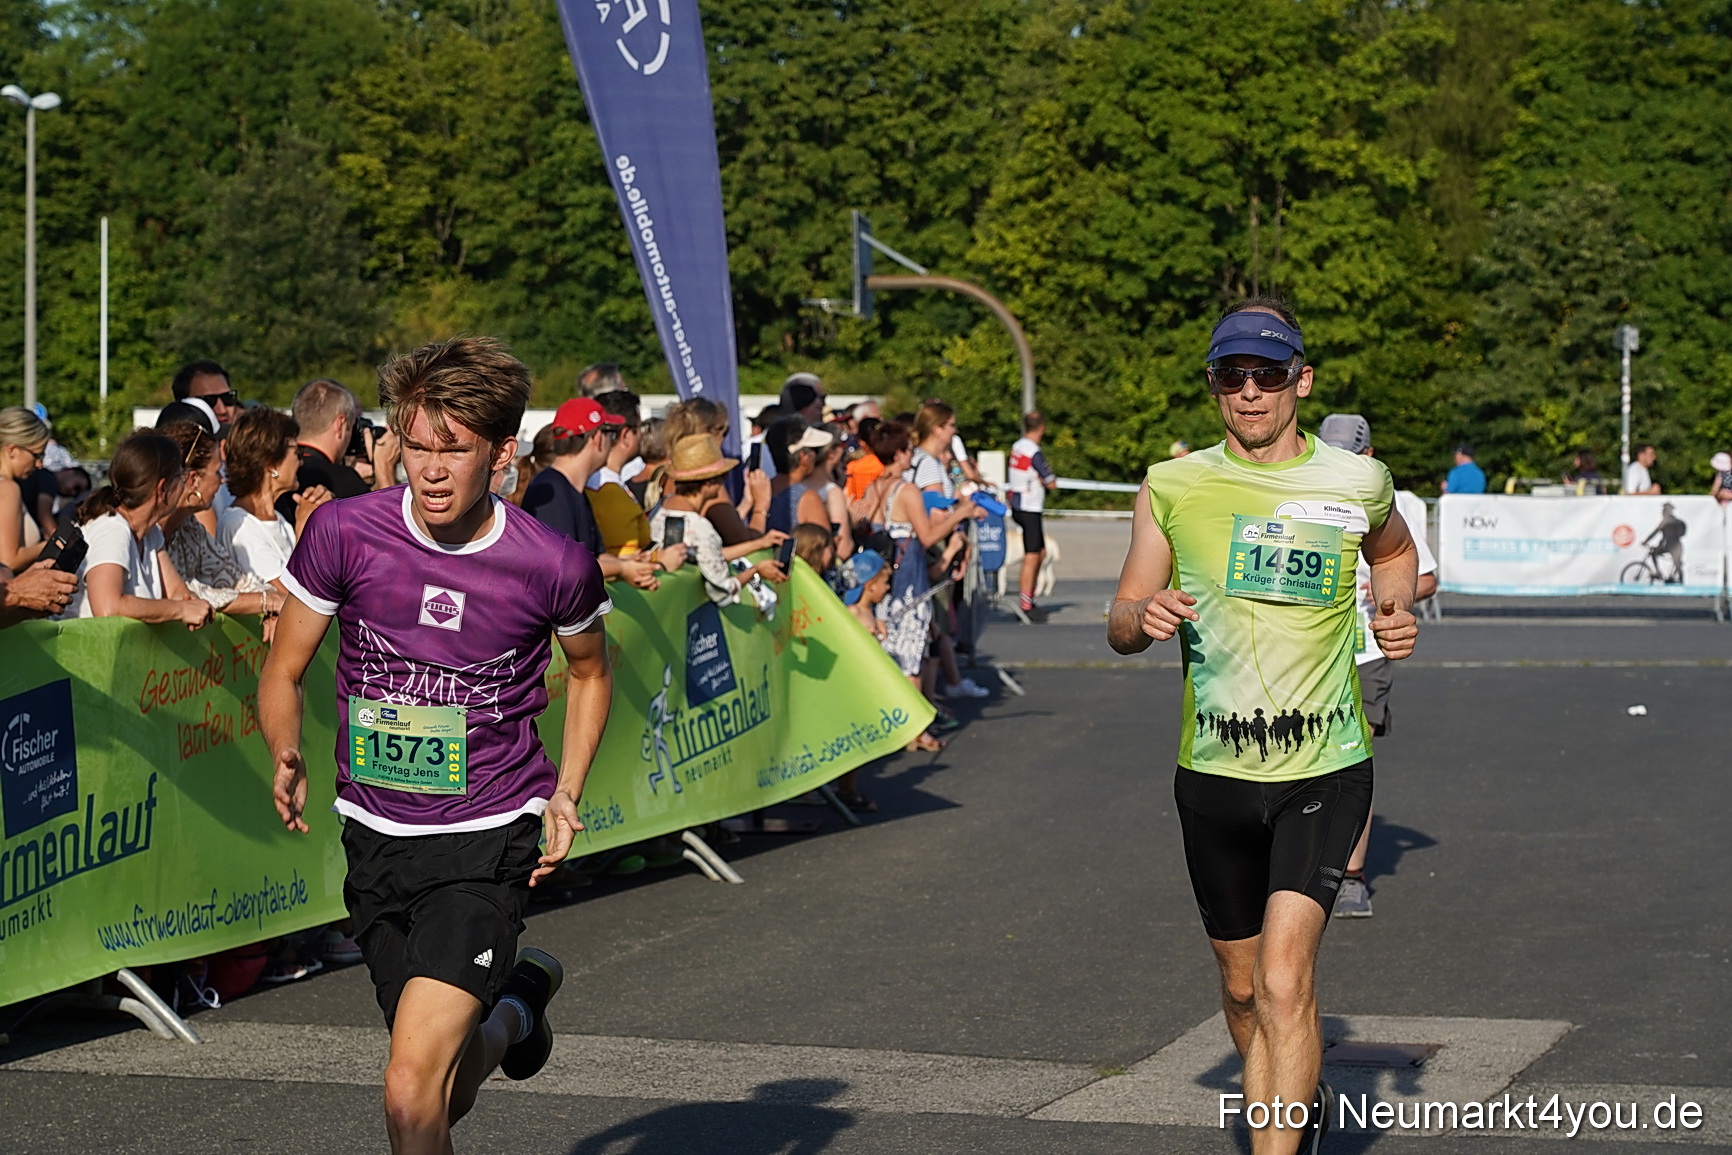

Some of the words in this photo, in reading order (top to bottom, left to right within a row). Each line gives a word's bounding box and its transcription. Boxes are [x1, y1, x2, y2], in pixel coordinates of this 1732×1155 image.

[1261, 329, 1288, 341] 2XU
[1324, 505, 1351, 514] Klinikum
[1260, 533, 1296, 541] Firmenlauf
[1233, 552, 1246, 580] RUN
[1249, 545, 1322, 577] 1459
[1243, 572, 1277, 586] Krüger
[1278, 577, 1323, 591] Christian
[1321, 558, 1335, 595] 2022
[424, 601, 460, 616] FUCHS
[140, 641, 226, 715] Gesunde
[177, 702, 234, 762] laufen
[240, 693, 262, 738] lä
[375, 718, 412, 728] Firmenlauf
[13, 729, 59, 763] Fischer
[356, 736, 366, 766] RUN
[367, 731, 446, 766] 1573
[18, 752, 55, 776] AUTOMOBILE
[372, 761, 410, 778] Freytag
[413, 767, 440, 778] Jens
[448, 743, 460, 782] 2022
[97, 868, 308, 951] www.firmenlauf-oberpfalz.de
